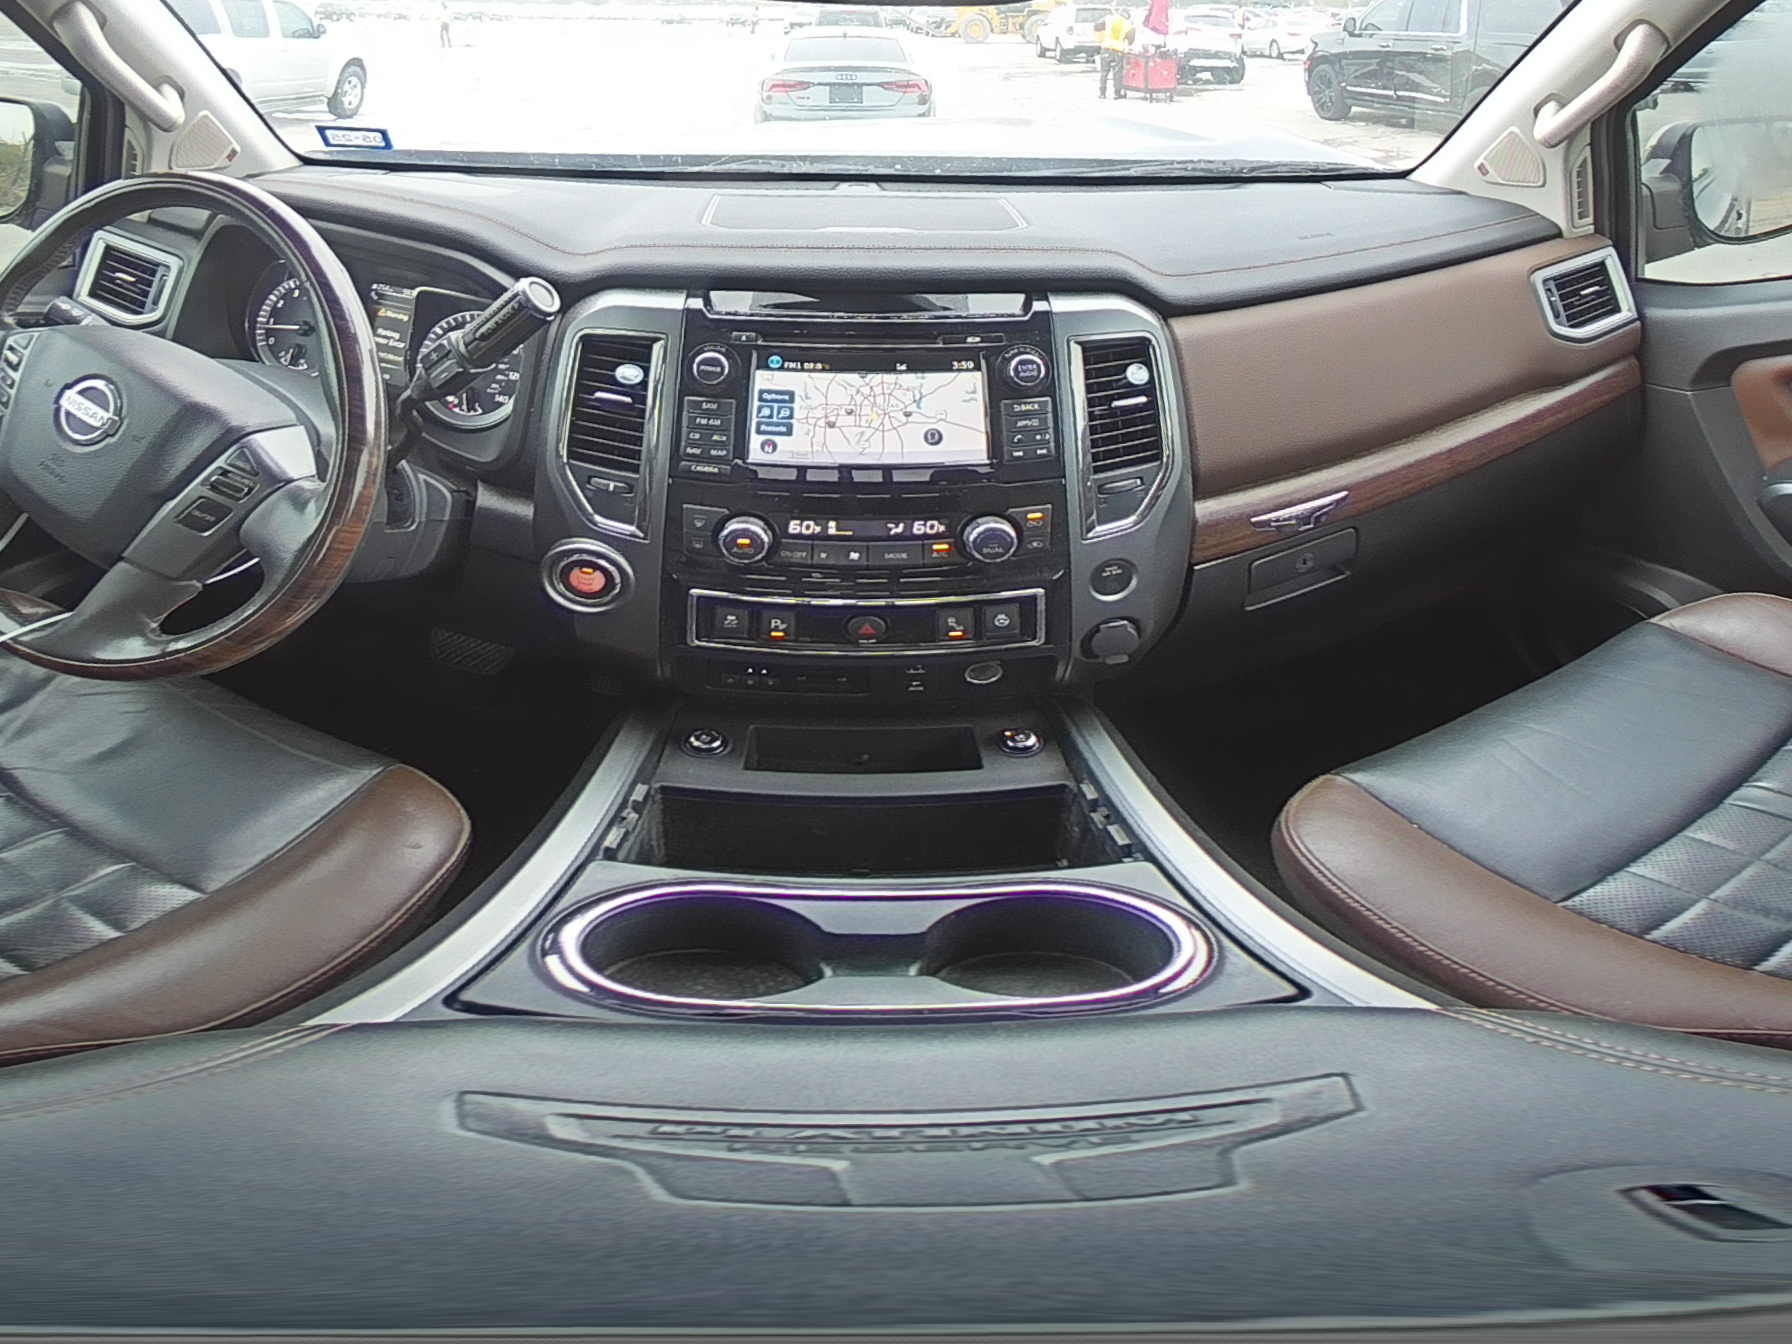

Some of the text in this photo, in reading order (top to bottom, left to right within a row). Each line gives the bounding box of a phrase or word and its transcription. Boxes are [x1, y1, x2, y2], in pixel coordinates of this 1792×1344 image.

[65, 395, 107, 427] NISSAN
[731, 545, 755, 555] AUTO
[884, 551, 908, 560] MODE
[649, 1113, 1202, 1141] PLATINUM
[727, 1134, 1136, 1154] RESERVE
